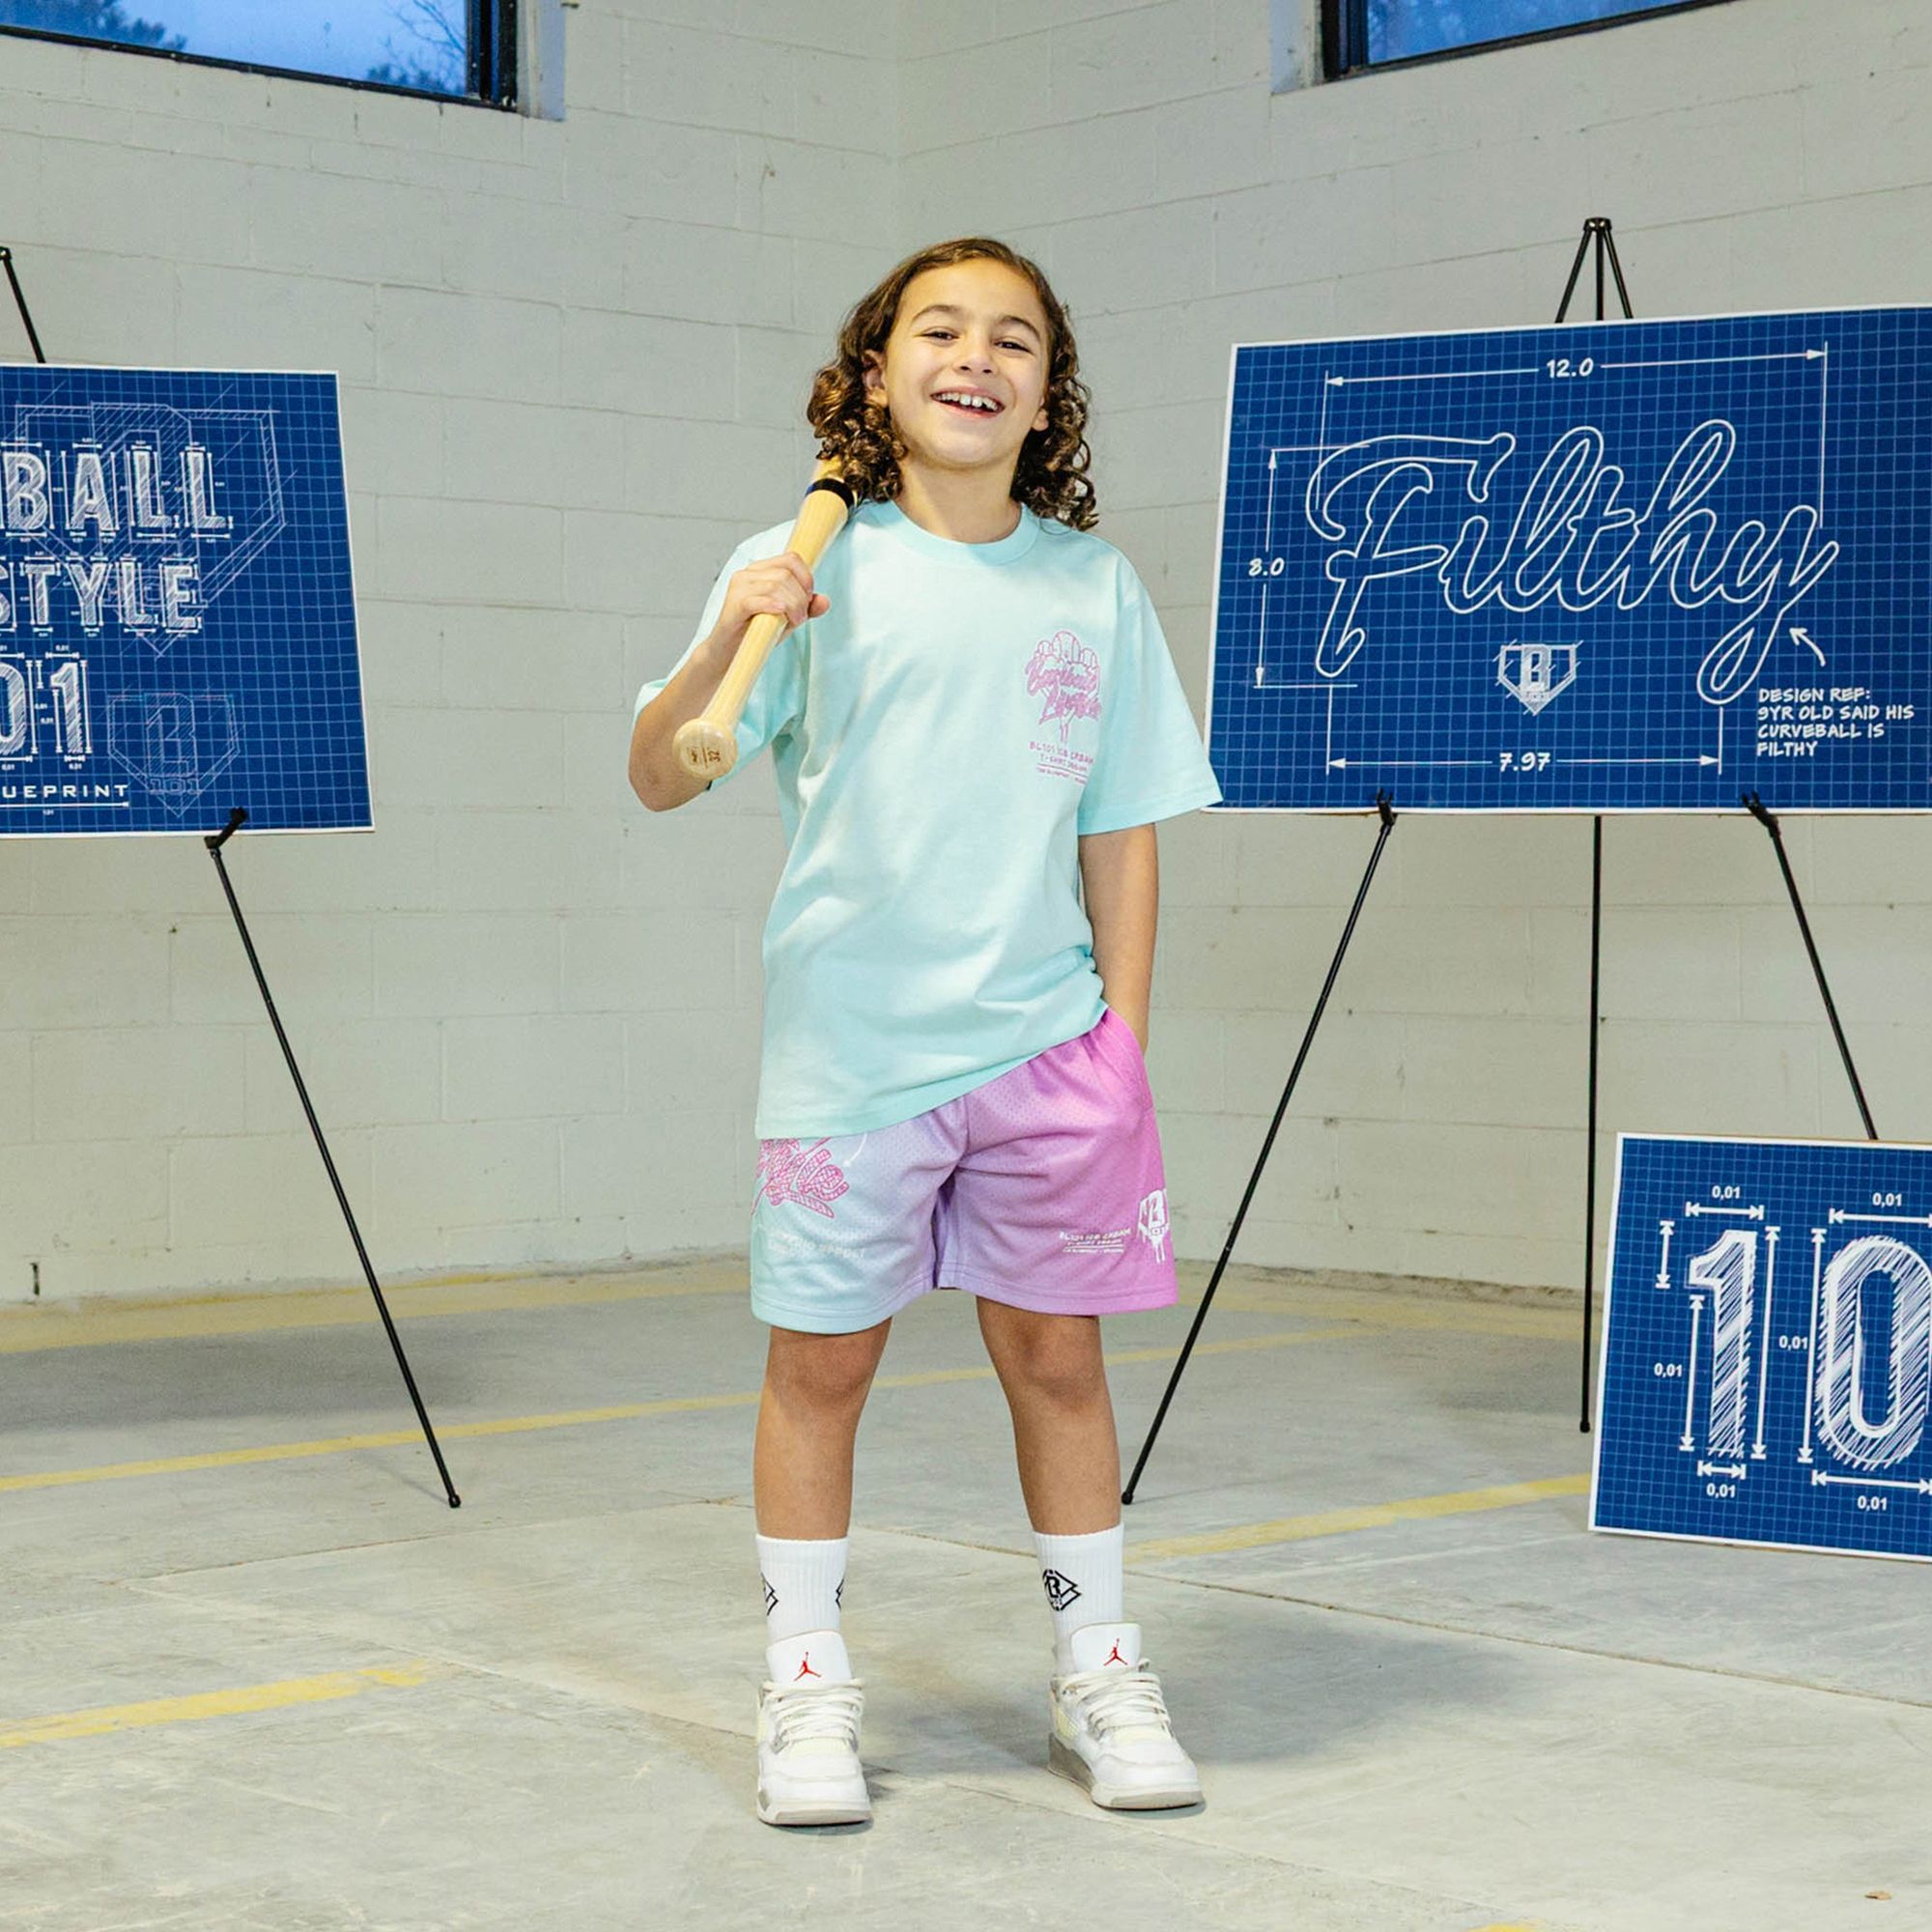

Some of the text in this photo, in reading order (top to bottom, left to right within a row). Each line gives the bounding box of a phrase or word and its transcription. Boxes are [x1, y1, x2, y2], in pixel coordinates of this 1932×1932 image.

[1547, 357, 1594, 378] 12.0
[1248, 557, 1285, 577] 8.0
[1306, 419, 1838, 704] Filthy
[1759, 687, 1871, 702] DESIGN REF:
[1758, 705, 1915, 721] 9YR OLD SAID HIS
[1758, 724, 1885, 738] CURVEBALL IS
[1756, 741, 1818, 757] FILTHY
[1499, 753, 1550, 772] 7.97
[1712, 1185, 1741, 1201] 0,01
[1872, 1193, 1902, 1208] 0,01
[1685, 1229, 1932, 1472] 10
[1778, 1335, 1808, 1350] 0,01
[1654, 1363, 1682, 1378] 0,01
[1706, 1483, 1736, 1497] 0,01
[1857, 1495, 1888, 1511] 0,01
